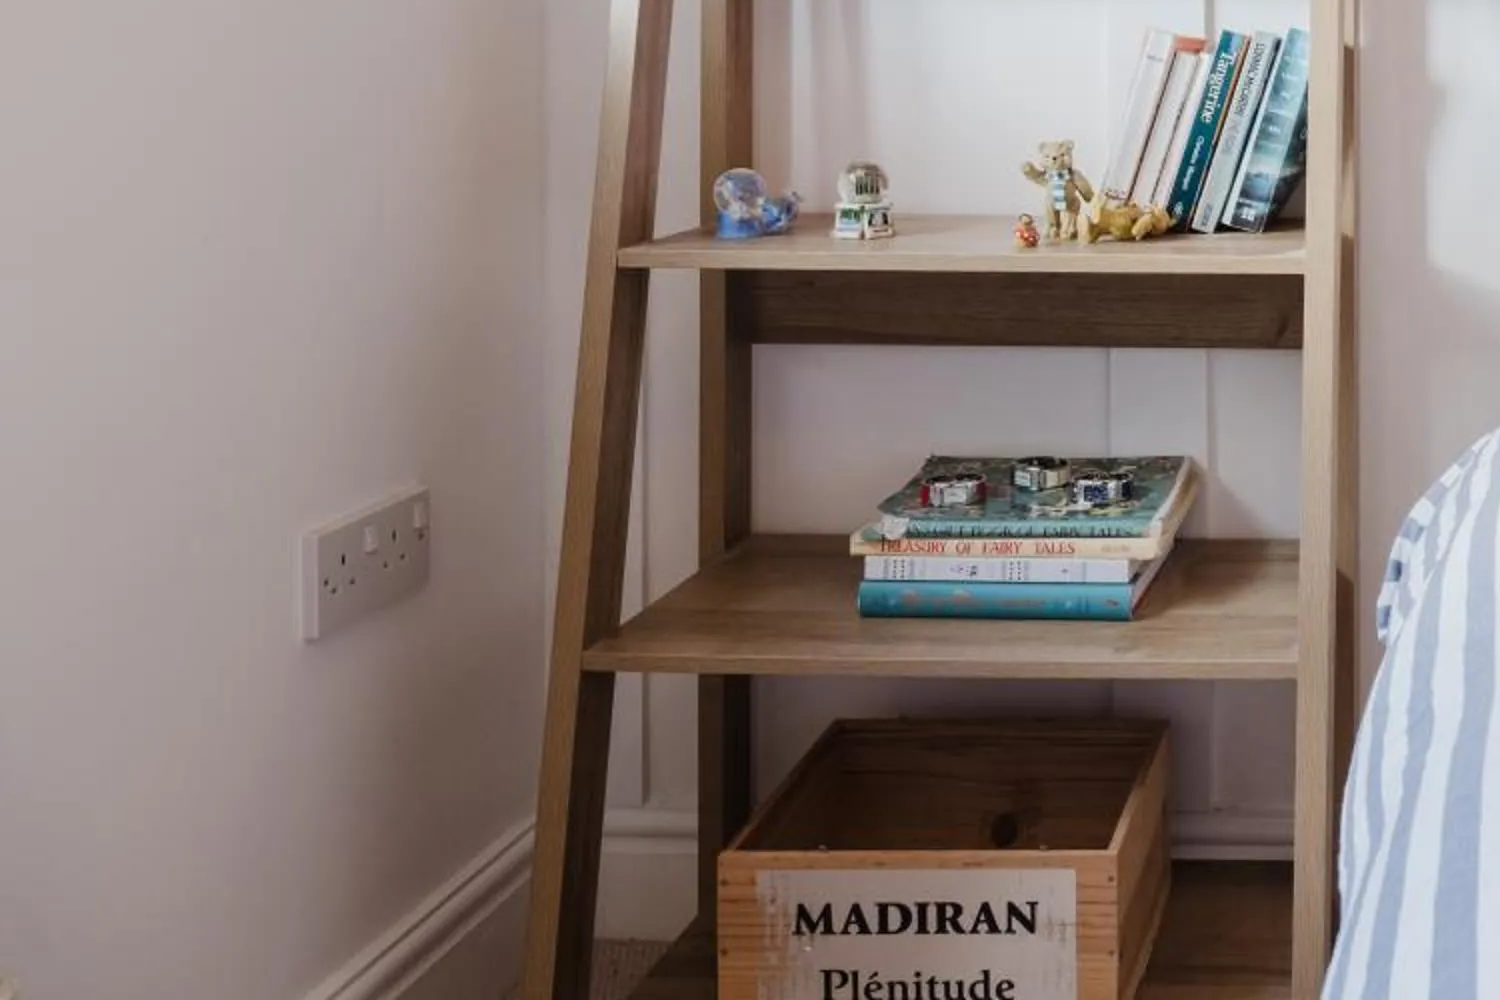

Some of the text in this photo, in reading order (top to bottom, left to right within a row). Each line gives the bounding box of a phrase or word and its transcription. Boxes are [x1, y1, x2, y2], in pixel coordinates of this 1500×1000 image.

[1201, 51, 1236, 124] Tangerine
[880, 540, 1076, 555] TREASURY OF FAIRY TALES
[791, 901, 1038, 936] MADIRAN
[820, 969, 1016, 1000] Plénitude
